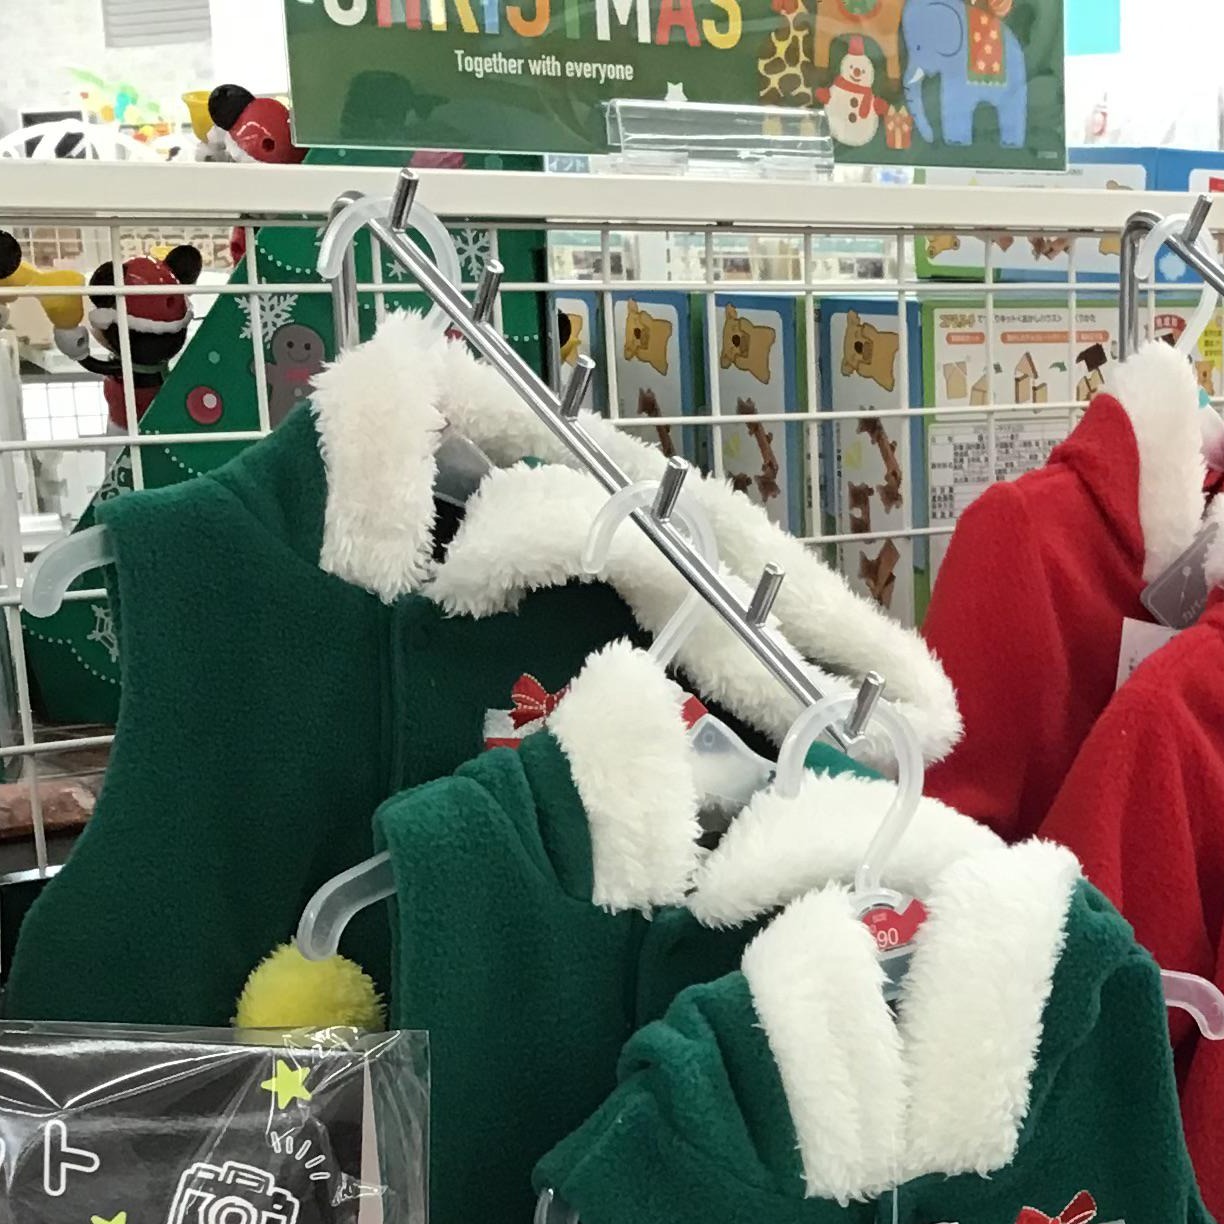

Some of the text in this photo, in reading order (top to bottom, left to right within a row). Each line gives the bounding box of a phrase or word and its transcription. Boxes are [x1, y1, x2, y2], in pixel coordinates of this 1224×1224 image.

[454, 49, 634, 84] Together with everyone
[877, 927, 899, 947] 90
